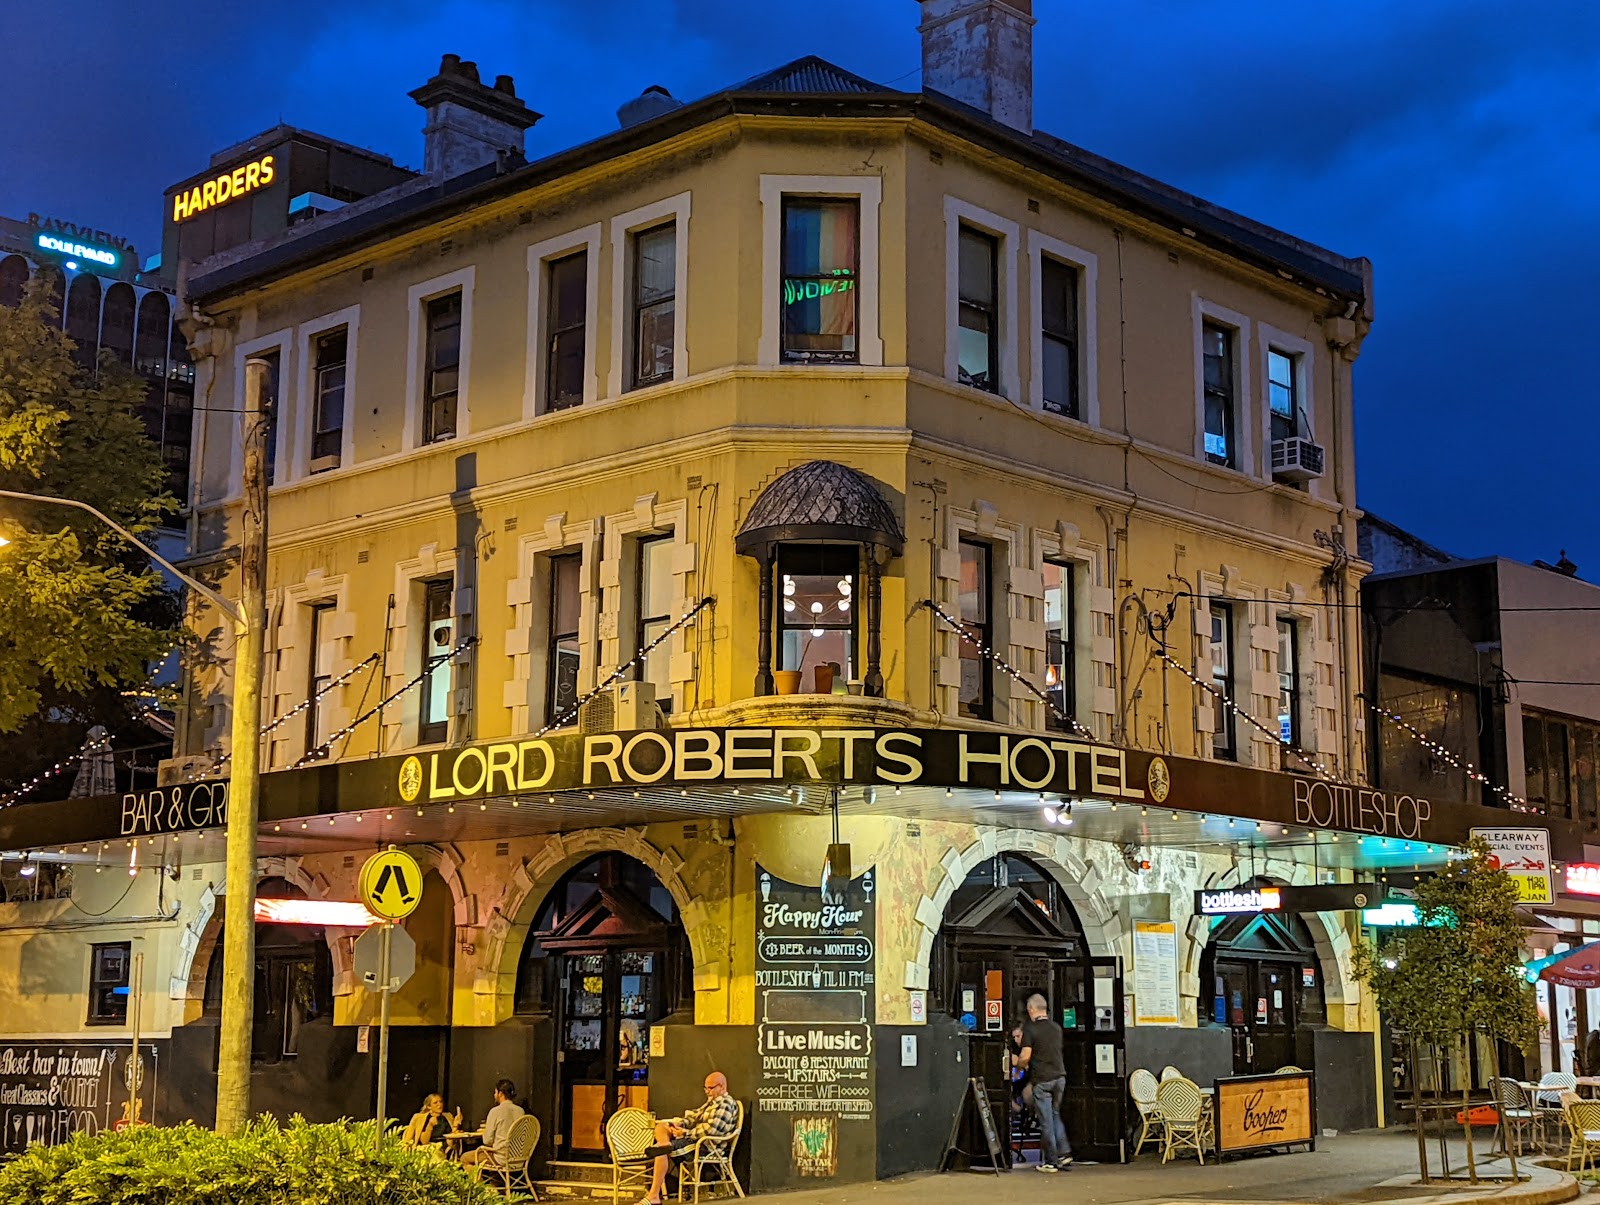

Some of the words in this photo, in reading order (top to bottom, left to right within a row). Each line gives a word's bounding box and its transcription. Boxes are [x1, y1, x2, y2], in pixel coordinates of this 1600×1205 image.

[173, 155, 274, 222] HARDERS
[28, 212, 127, 250] BAYVIEW
[38, 235, 115, 265] BOULEVARD
[429, 740, 555, 798] LORD
[583, 729, 923, 784] ROBERTS
[958, 734, 1145, 799] HOTEL
[120, 791, 165, 835] BAR
[167, 787, 185, 829] &
[188, 782, 230, 827] GRI
[1294, 779, 1431, 839] BOTTLESHOP
[1481, 833, 1539, 842] CLEARWAY
[763, 903, 821, 929] Happy
[821, 905, 863, 928] Hour
[779, 944, 805, 955] BEER
[824, 944, 855, 955] MONTH
[755, 970, 811, 987] BOTTLESHOP
[848, 970, 865, 987] PM
[1560, 977, 1595, 986] TSINGTAO
[767, 1030, 806, 1050] Live
[808, 1030, 862, 1050] Music
[0, 1048, 30, 1075] Best
[32, 1049, 54, 1075] bar
[57, 1049, 70, 1075] in
[71, 1049, 106, 1077] town!
[763, 1056, 800, 1070] BALCONY
[787, 1069, 836, 1082] UPSTAIRS
[1, 1083, 17, 1105] Great
[17, 1083, 48, 1106] Classics
[48, 1076, 60, 1107] &
[60, 1077, 100, 1108] GOURMET
[780, 1084, 813, 1099] FREE
[815, 1084, 841, 1099] WIFI
[1243, 1088, 1288, 1135] Coopers
